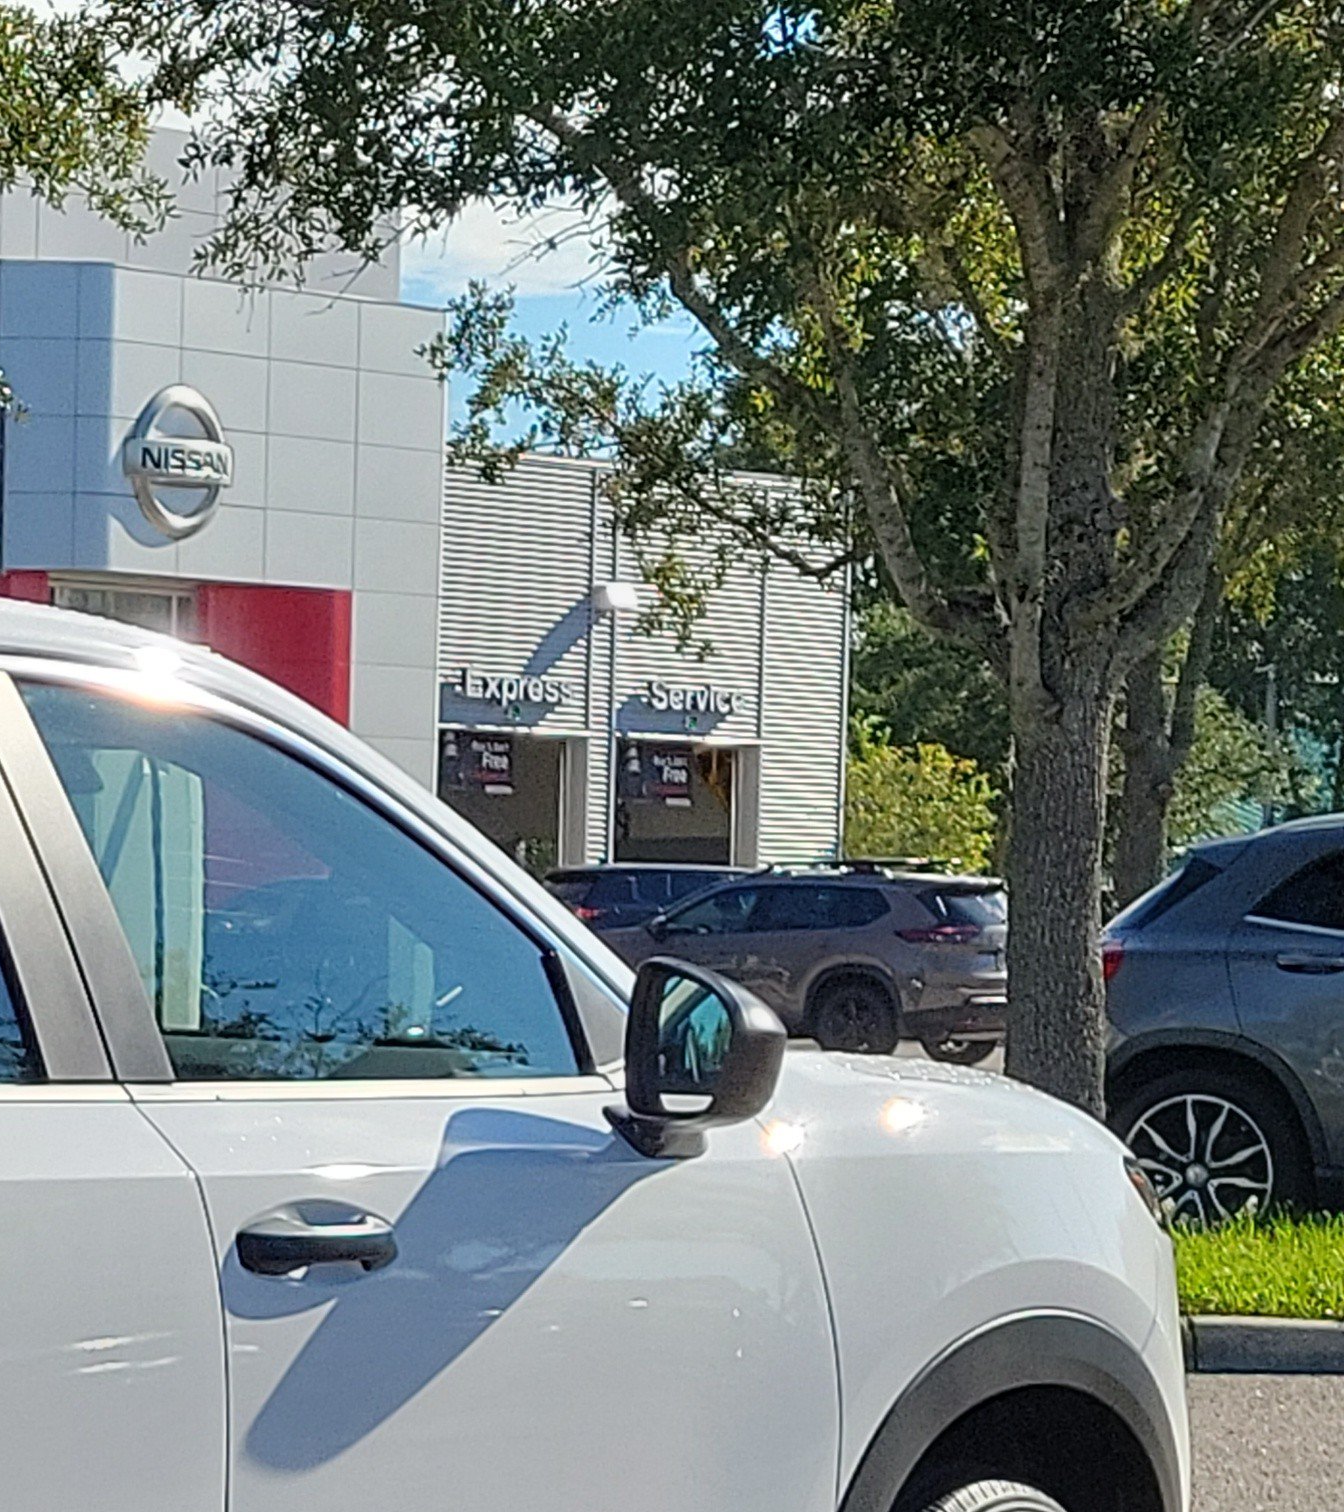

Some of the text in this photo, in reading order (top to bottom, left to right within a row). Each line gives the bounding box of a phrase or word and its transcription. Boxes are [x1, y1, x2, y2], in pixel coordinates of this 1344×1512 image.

[141, 446, 228, 476] NISSAN
[466, 669, 572, 708] Express
[652, 681, 745, 714] Service
